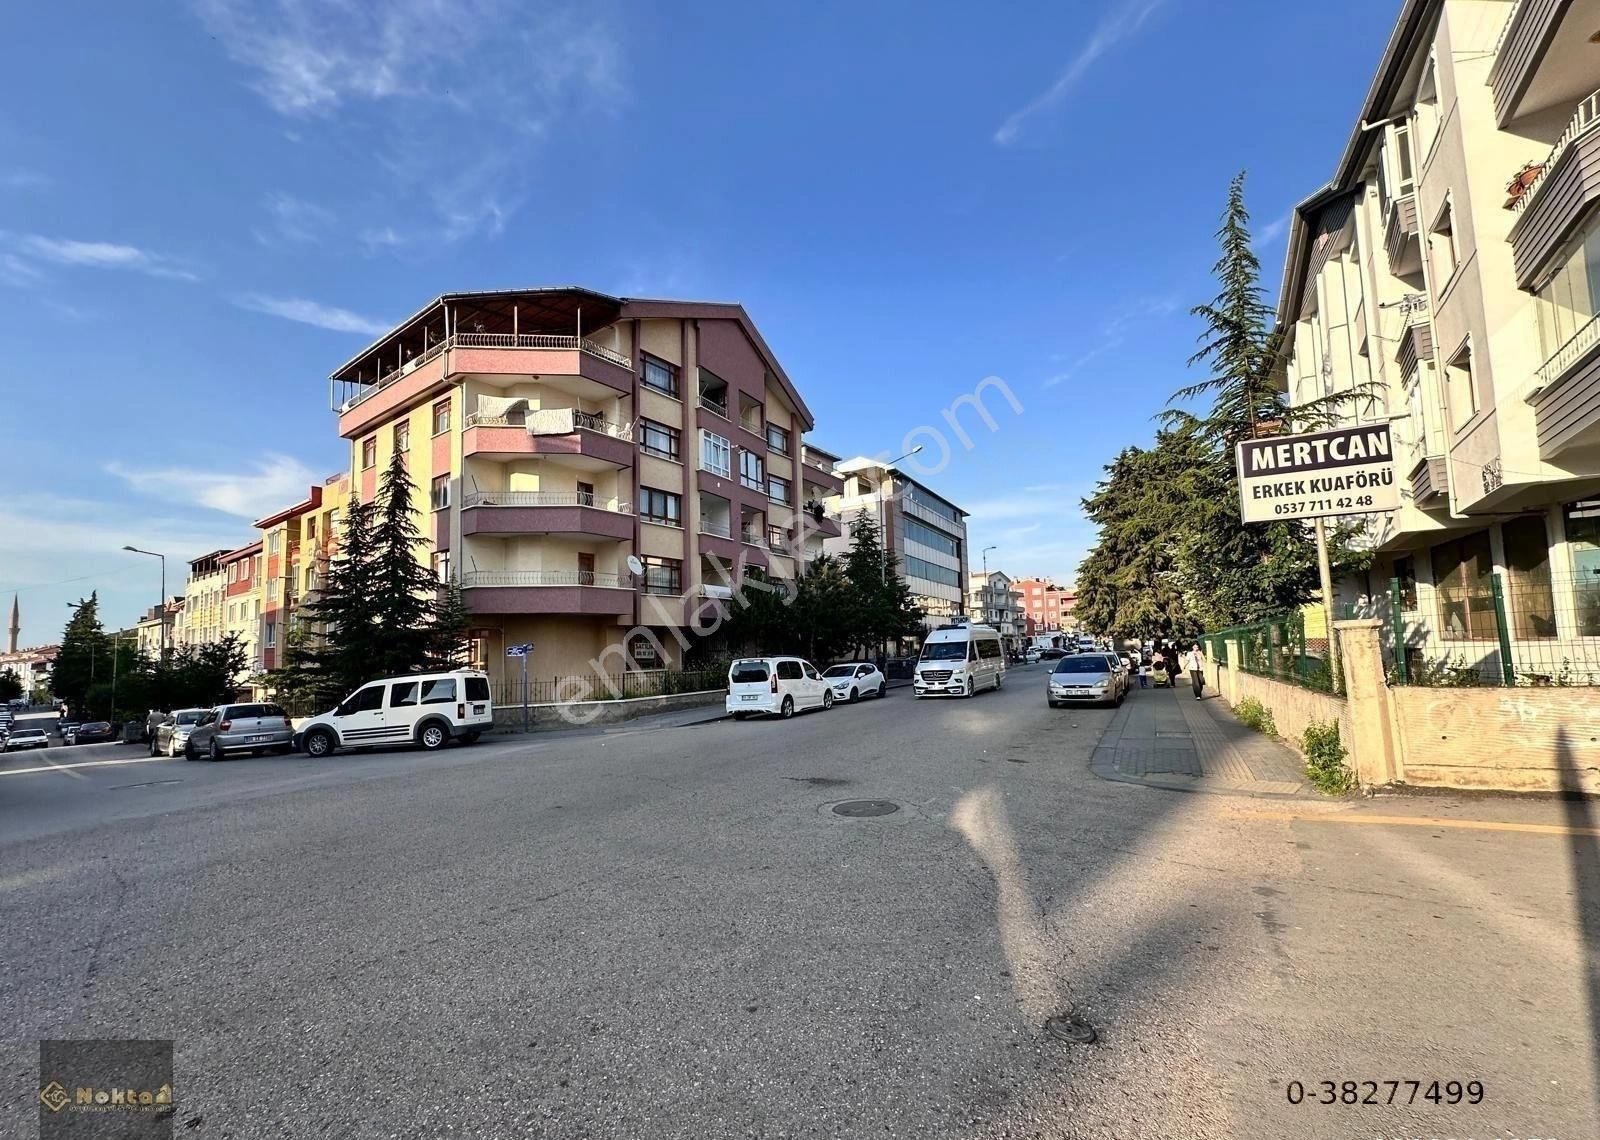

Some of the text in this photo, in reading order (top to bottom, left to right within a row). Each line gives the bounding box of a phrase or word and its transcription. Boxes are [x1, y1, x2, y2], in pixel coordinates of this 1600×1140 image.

[1251, 431, 1390, 471] MERTCAN
[1253, 467, 1393, 500] ERKEK KUAFÖRÜ
[1274, 495, 1373, 515] 0537 711 42 48
